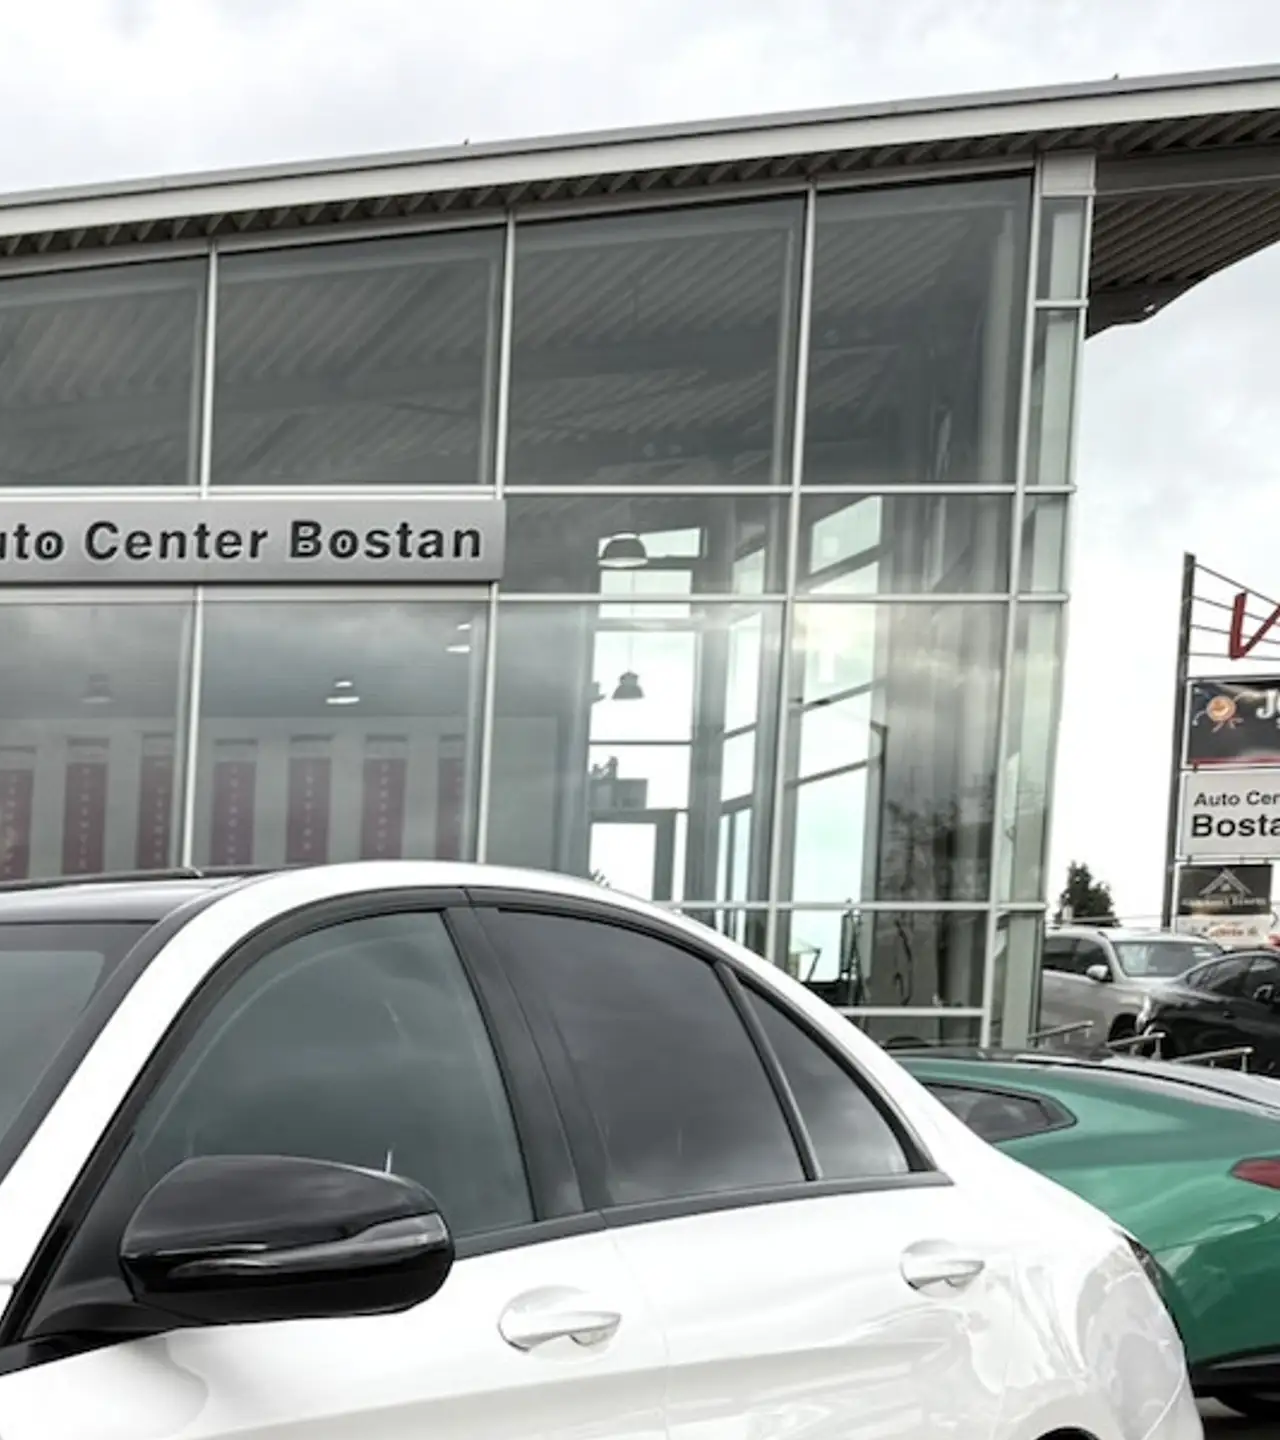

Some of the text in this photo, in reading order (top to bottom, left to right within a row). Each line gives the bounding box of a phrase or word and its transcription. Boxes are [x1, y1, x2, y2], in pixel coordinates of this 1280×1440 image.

[84, 518, 269, 561] Center
[289, 519, 481, 560] Bostan
[1194, 792, 1241, 807] Auto
